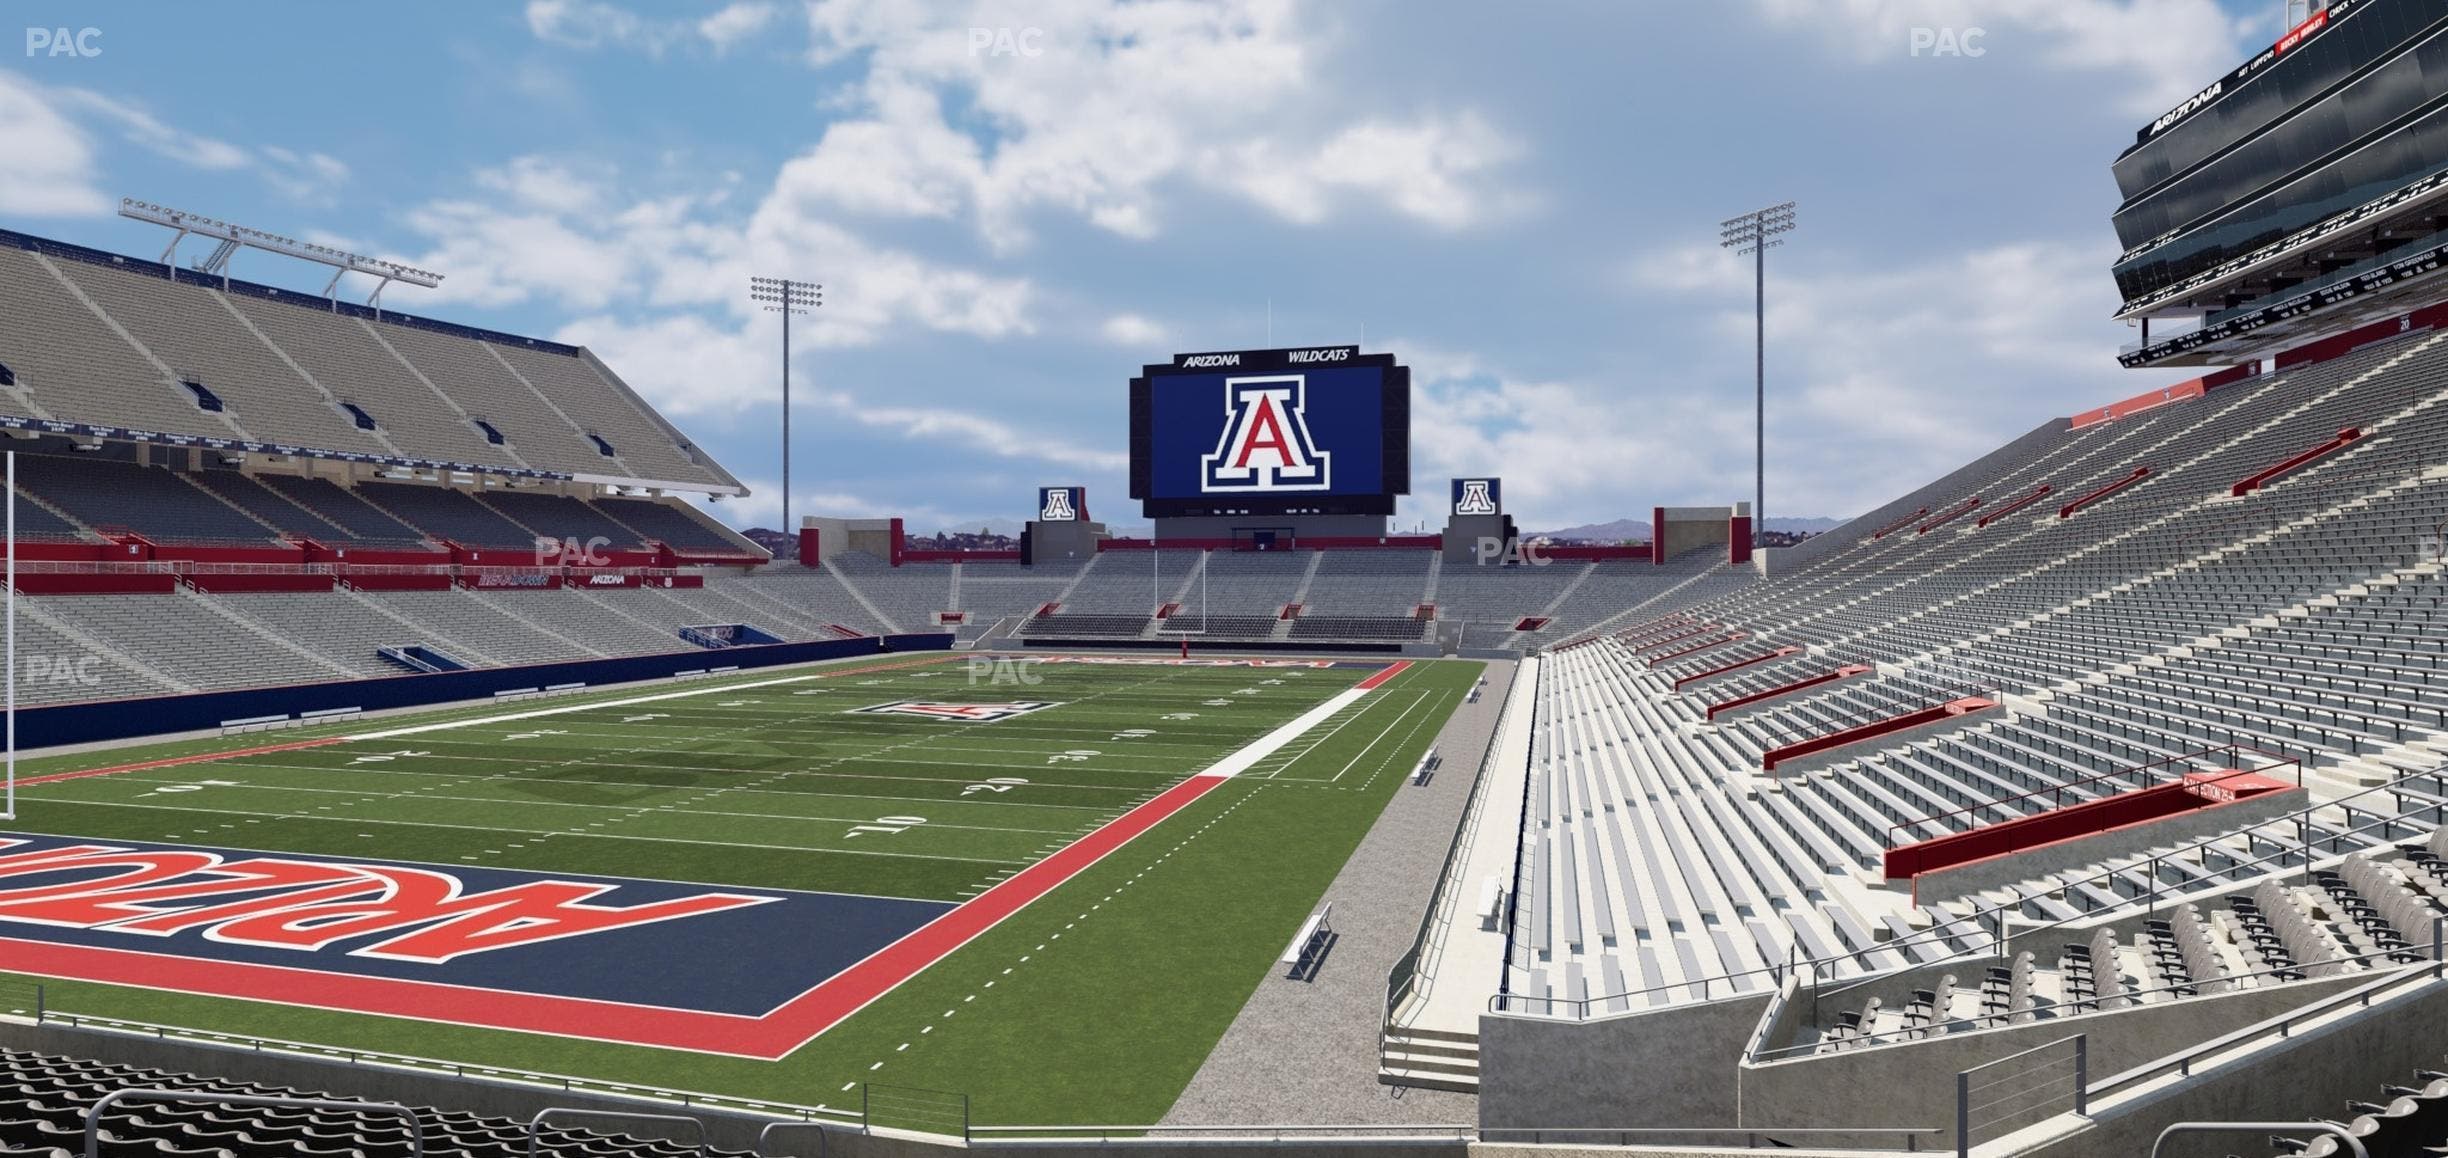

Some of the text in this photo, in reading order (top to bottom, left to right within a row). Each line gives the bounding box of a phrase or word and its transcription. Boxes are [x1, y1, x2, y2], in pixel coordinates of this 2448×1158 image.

[2149, 81, 2222, 136] ARIZONA
[2400, 319, 2410, 331] 20
[1183, 349, 1350, 368] ARIZONA WILDCATS
[1201, 374, 1330, 493] A
[1042, 489, 1075, 520] A
[1457, 481, 1495, 515] A
[590, 574, 625, 585] ARIZONA
[1049, 750, 1102, 762] 30
[964, 777, 1029, 793] 20
[848, 815, 928, 835] 10
